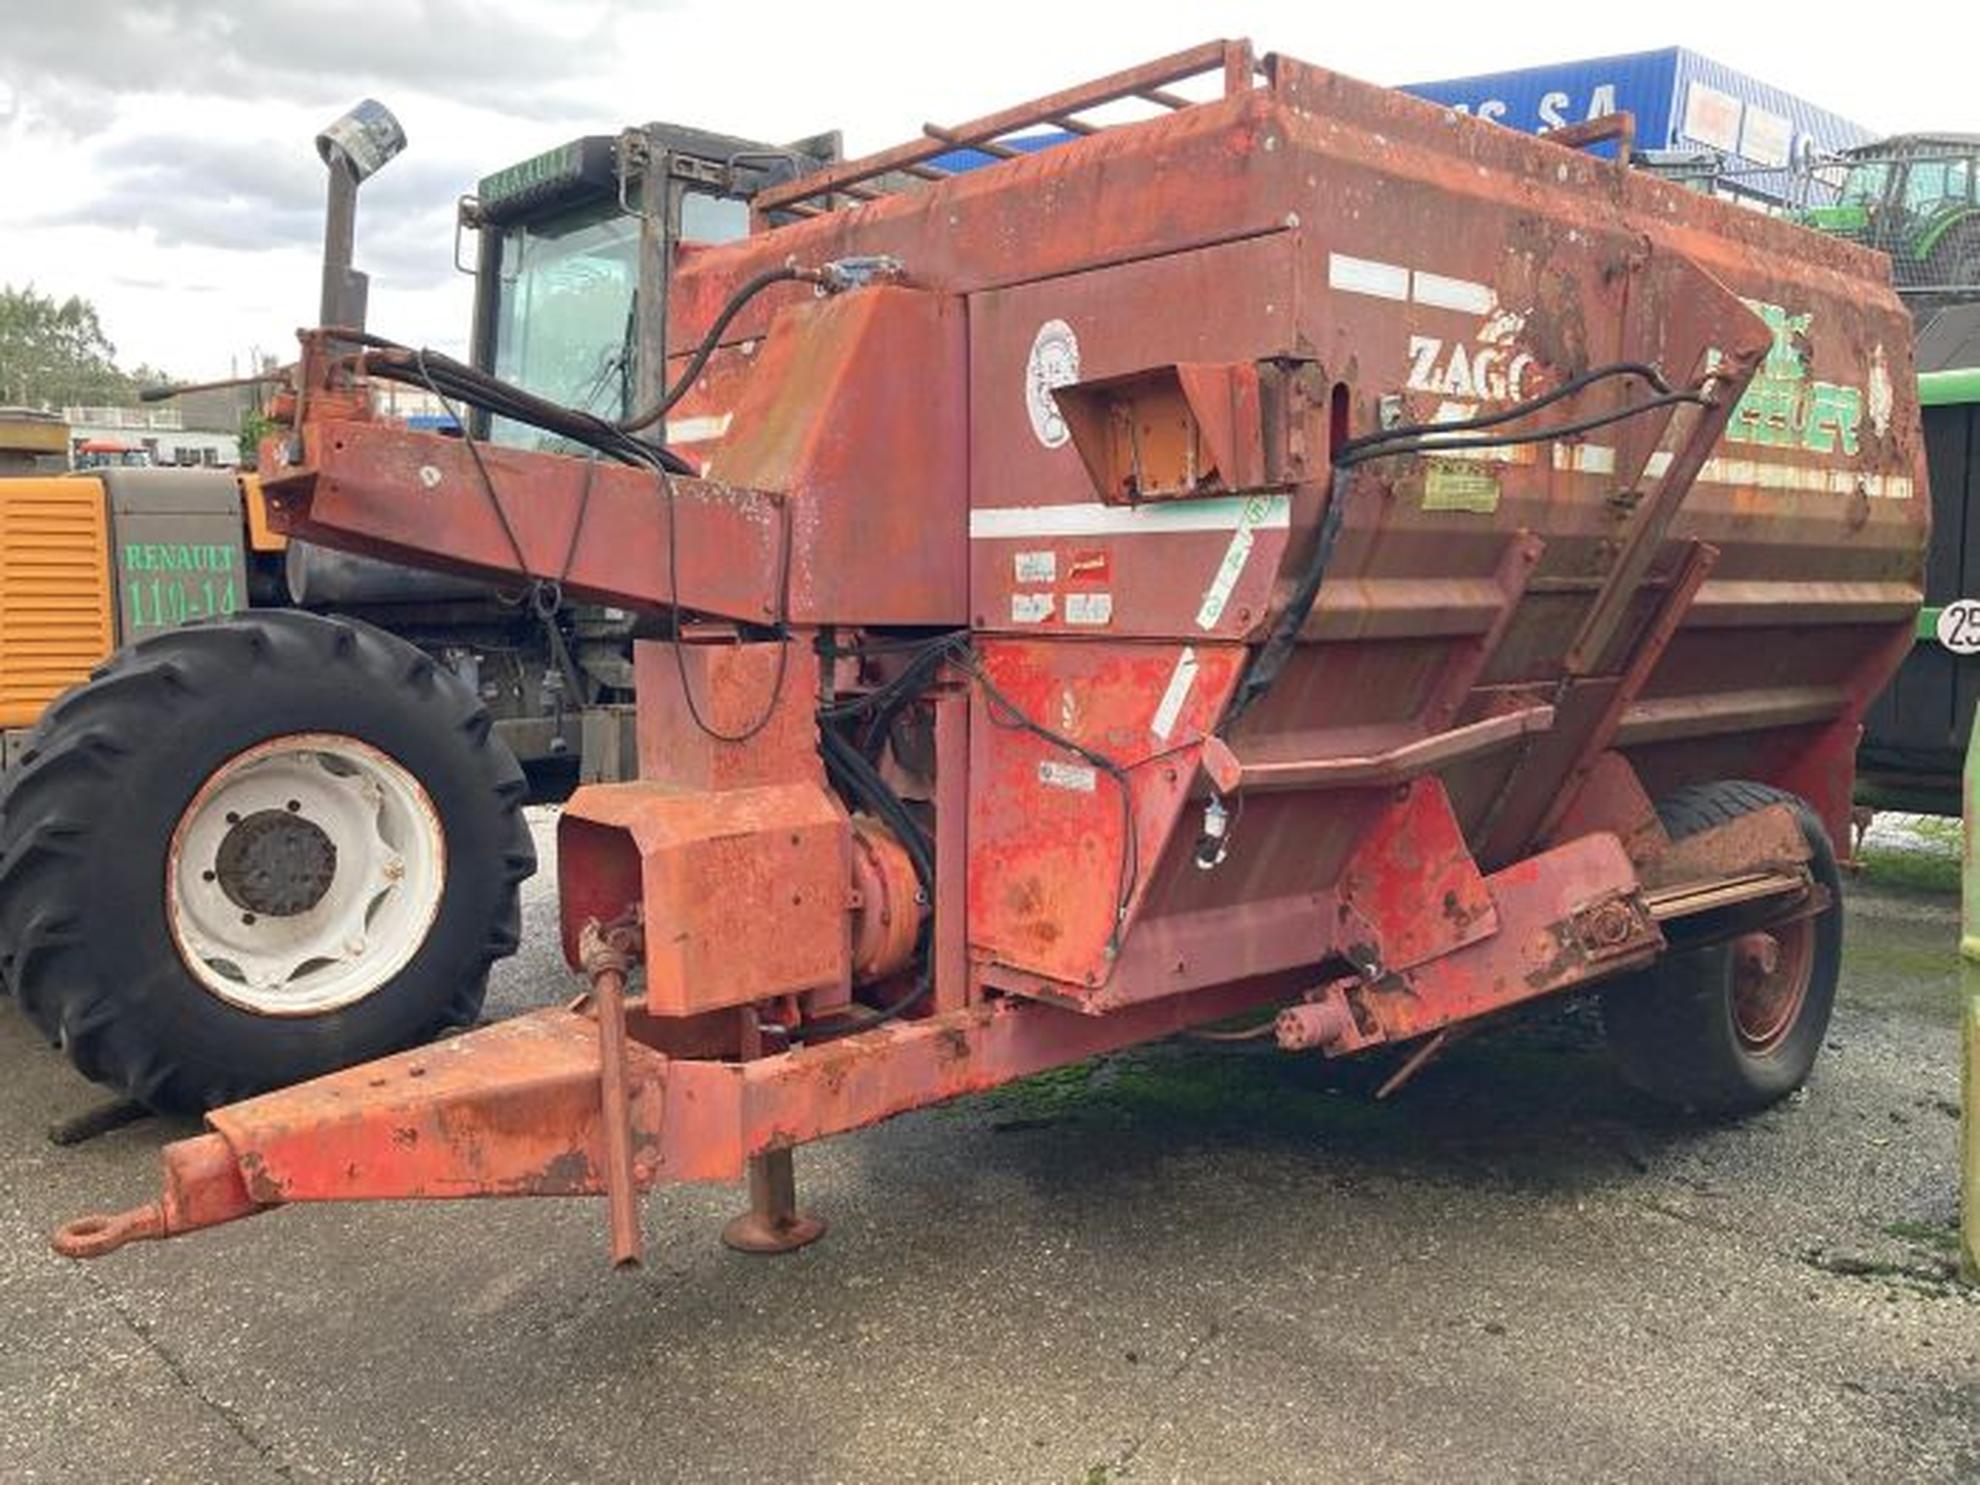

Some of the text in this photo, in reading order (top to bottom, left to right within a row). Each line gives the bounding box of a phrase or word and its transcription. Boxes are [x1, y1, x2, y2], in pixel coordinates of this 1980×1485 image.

[125, 544, 235, 571] RENAULT
[129, 577, 235, 627] 110-14
[1949, 606, 1980, 646] 25
